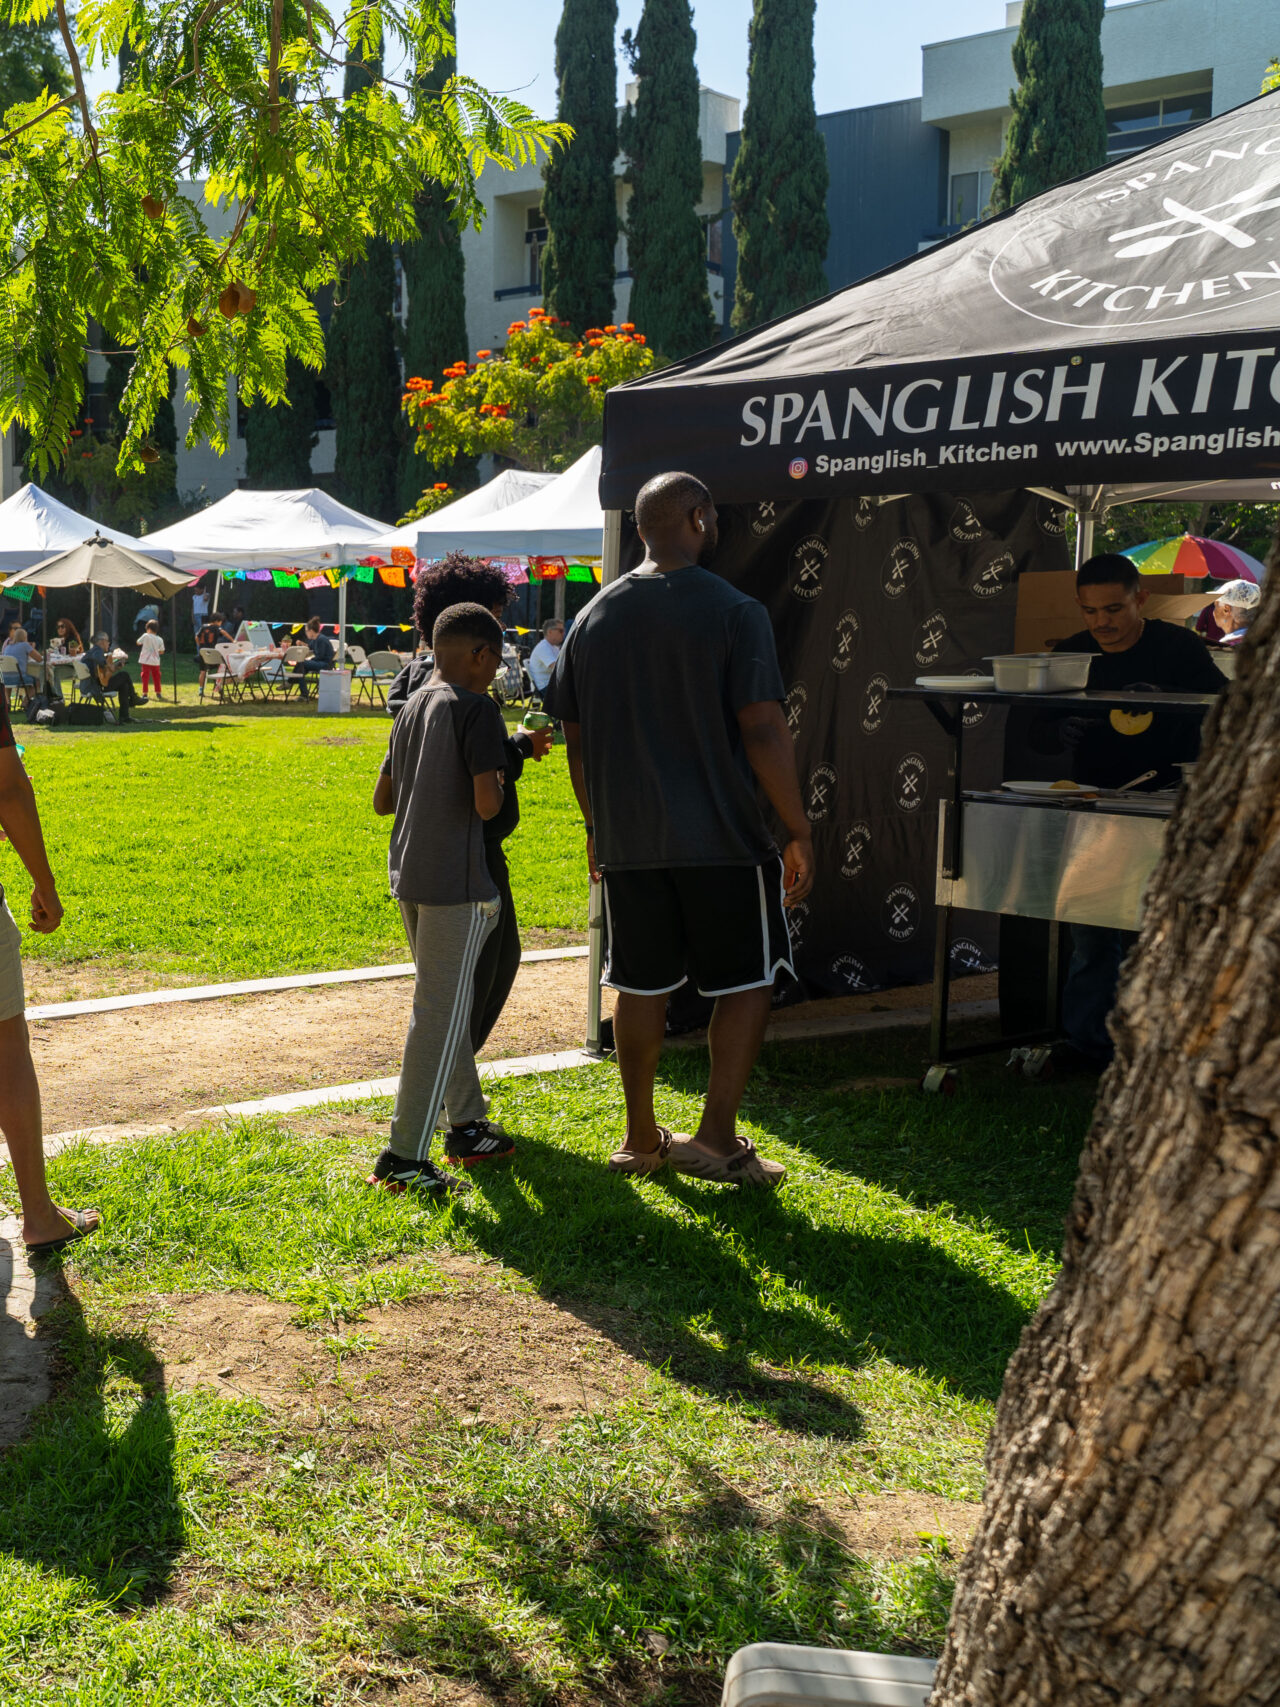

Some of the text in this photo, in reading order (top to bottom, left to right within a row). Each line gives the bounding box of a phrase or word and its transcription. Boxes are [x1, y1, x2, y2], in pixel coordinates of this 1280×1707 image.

[1029, 260, 1280, 312] KITCHEN
[740, 347, 1280, 447] SPANGLISH KIT
[815, 441, 1038, 477] Spanglish_Kitchen
[794, 539, 829, 559] SPANGLISH
[793, 583, 823, 598] KITCHEN
